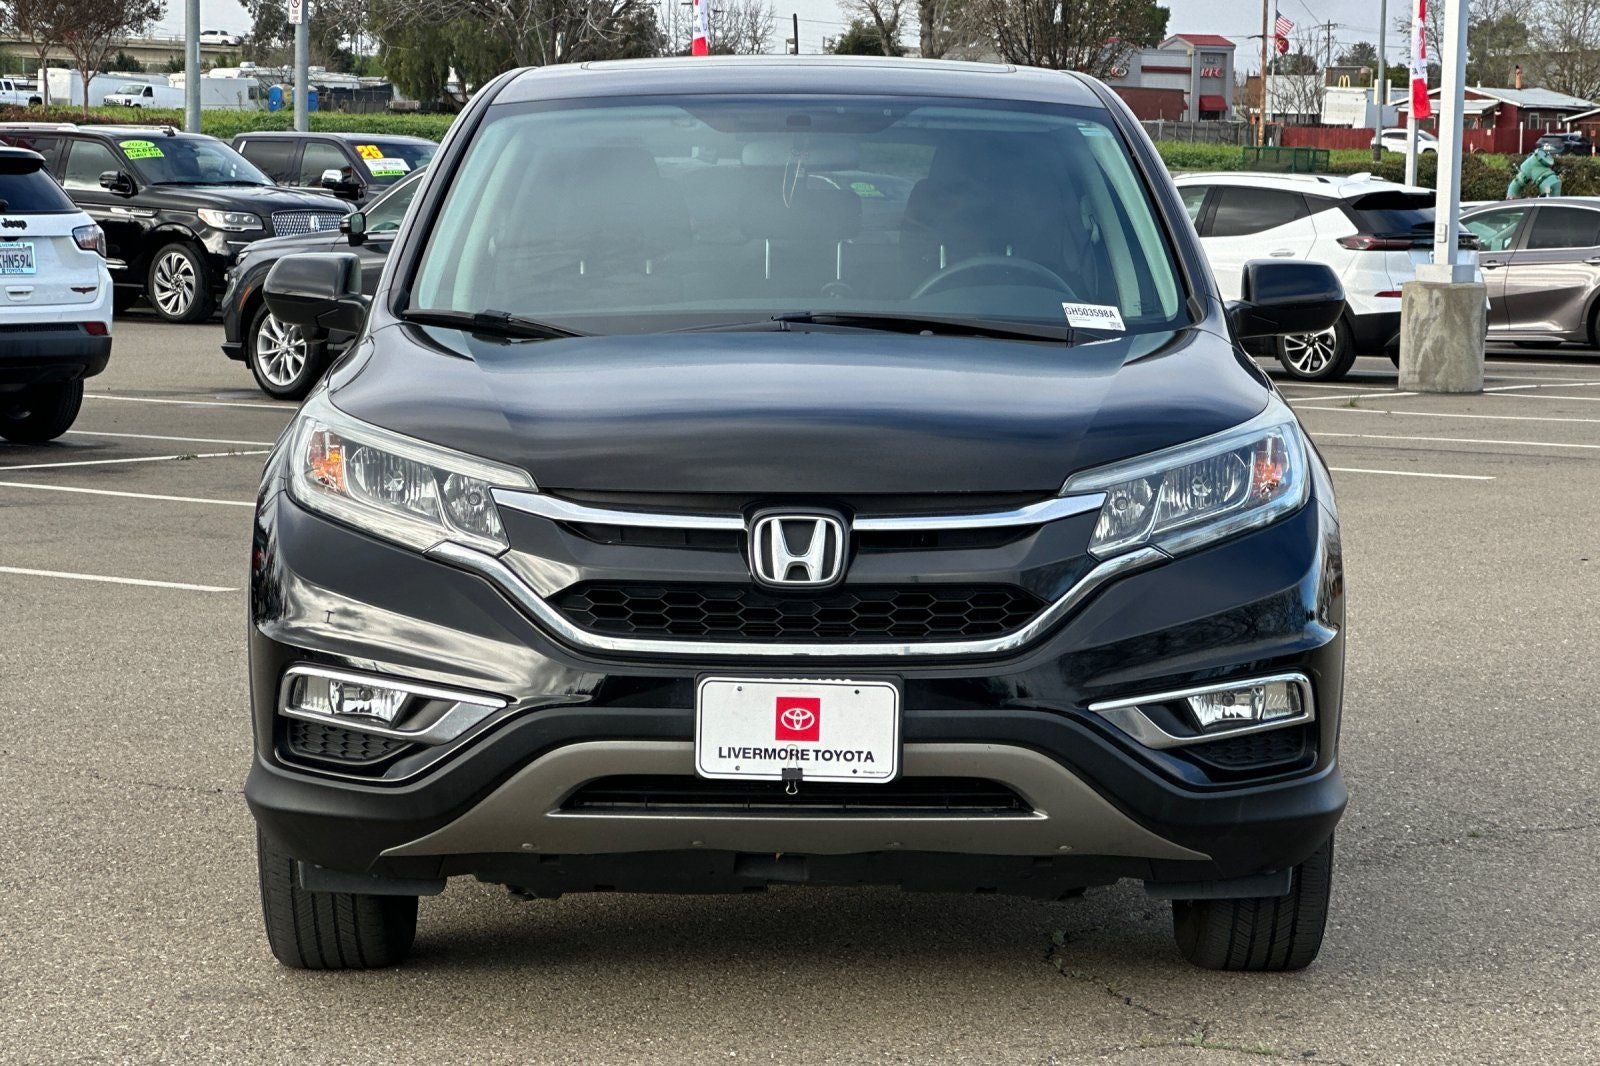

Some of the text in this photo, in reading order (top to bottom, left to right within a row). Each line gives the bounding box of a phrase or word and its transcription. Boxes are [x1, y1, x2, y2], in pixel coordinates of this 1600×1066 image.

[1, 217, 27, 230] Jeep
[718, 747, 874, 763] LIVERMORE TOYOTA
